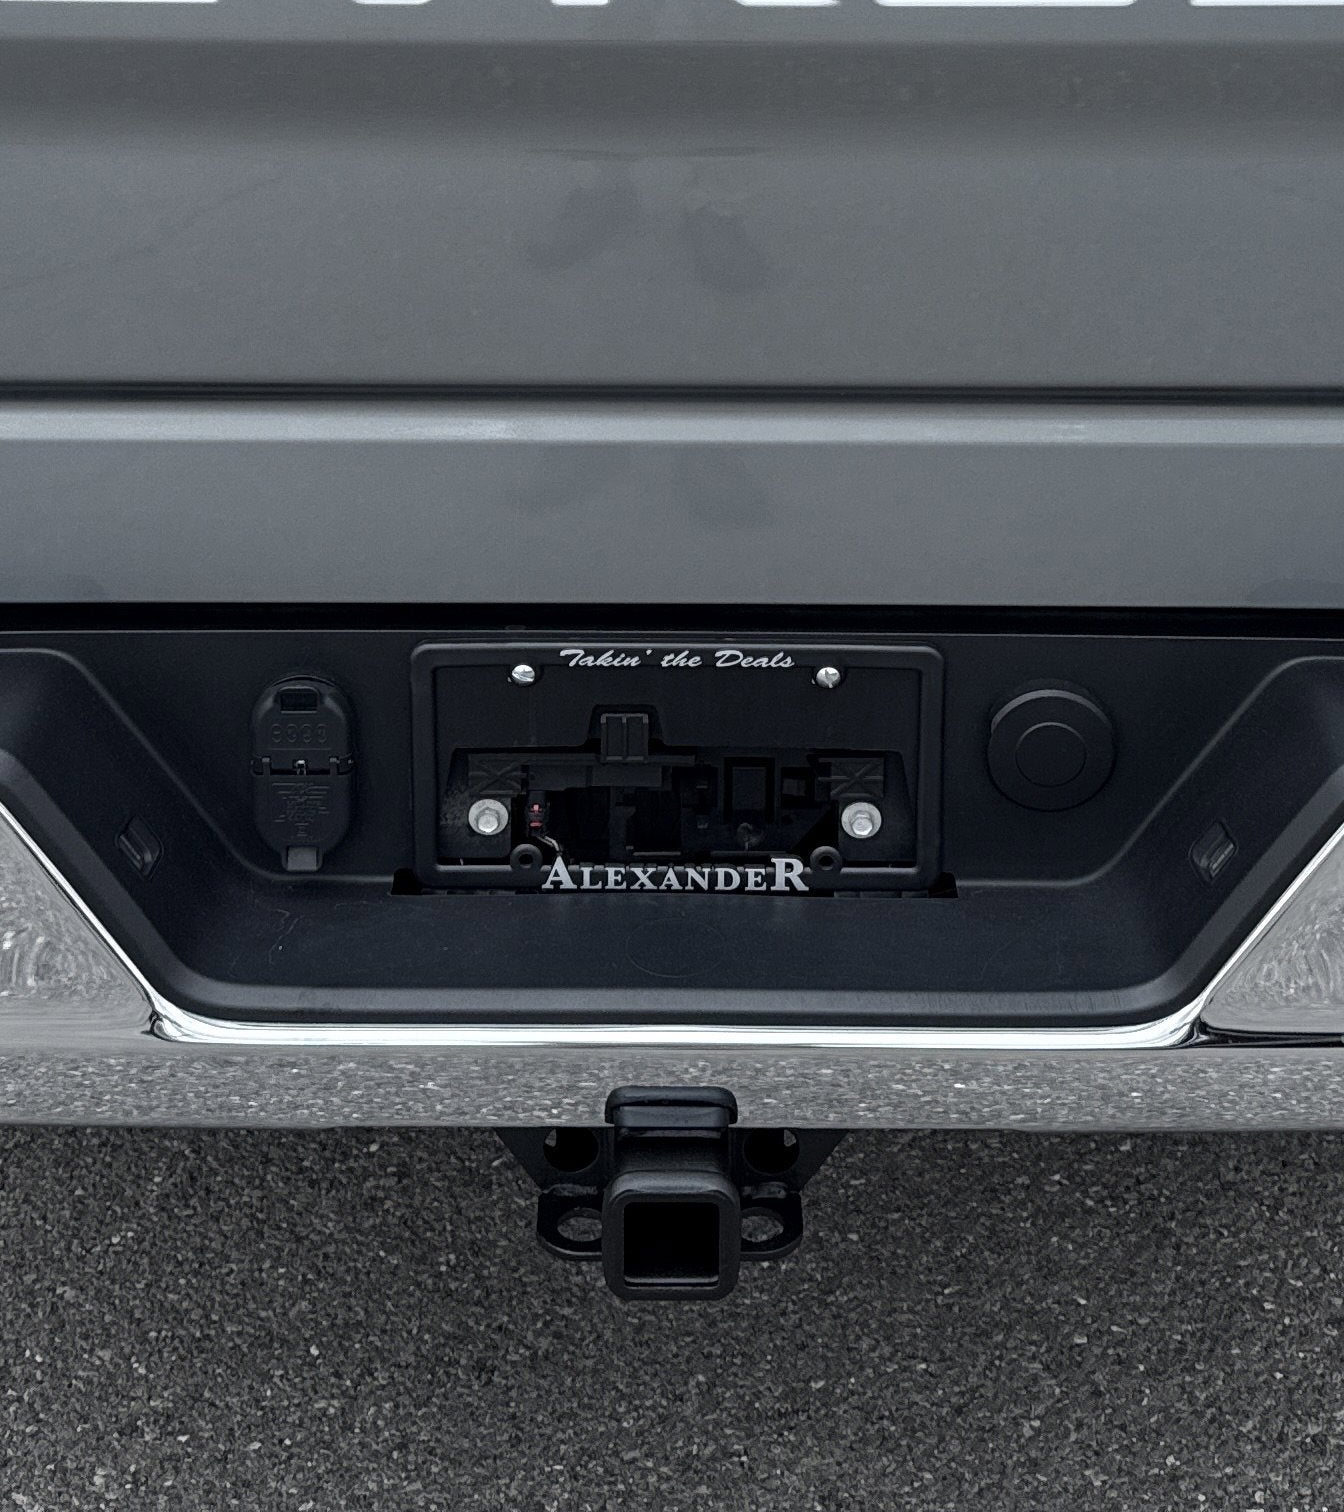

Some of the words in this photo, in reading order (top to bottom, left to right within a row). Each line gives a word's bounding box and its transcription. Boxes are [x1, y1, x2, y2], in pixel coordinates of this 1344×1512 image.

[559, 648, 654, 667] Takin'
[661, 649, 703, 667] the
[714, 649, 795, 668] Deals
[541, 855, 810, 891] ALEXANDER
